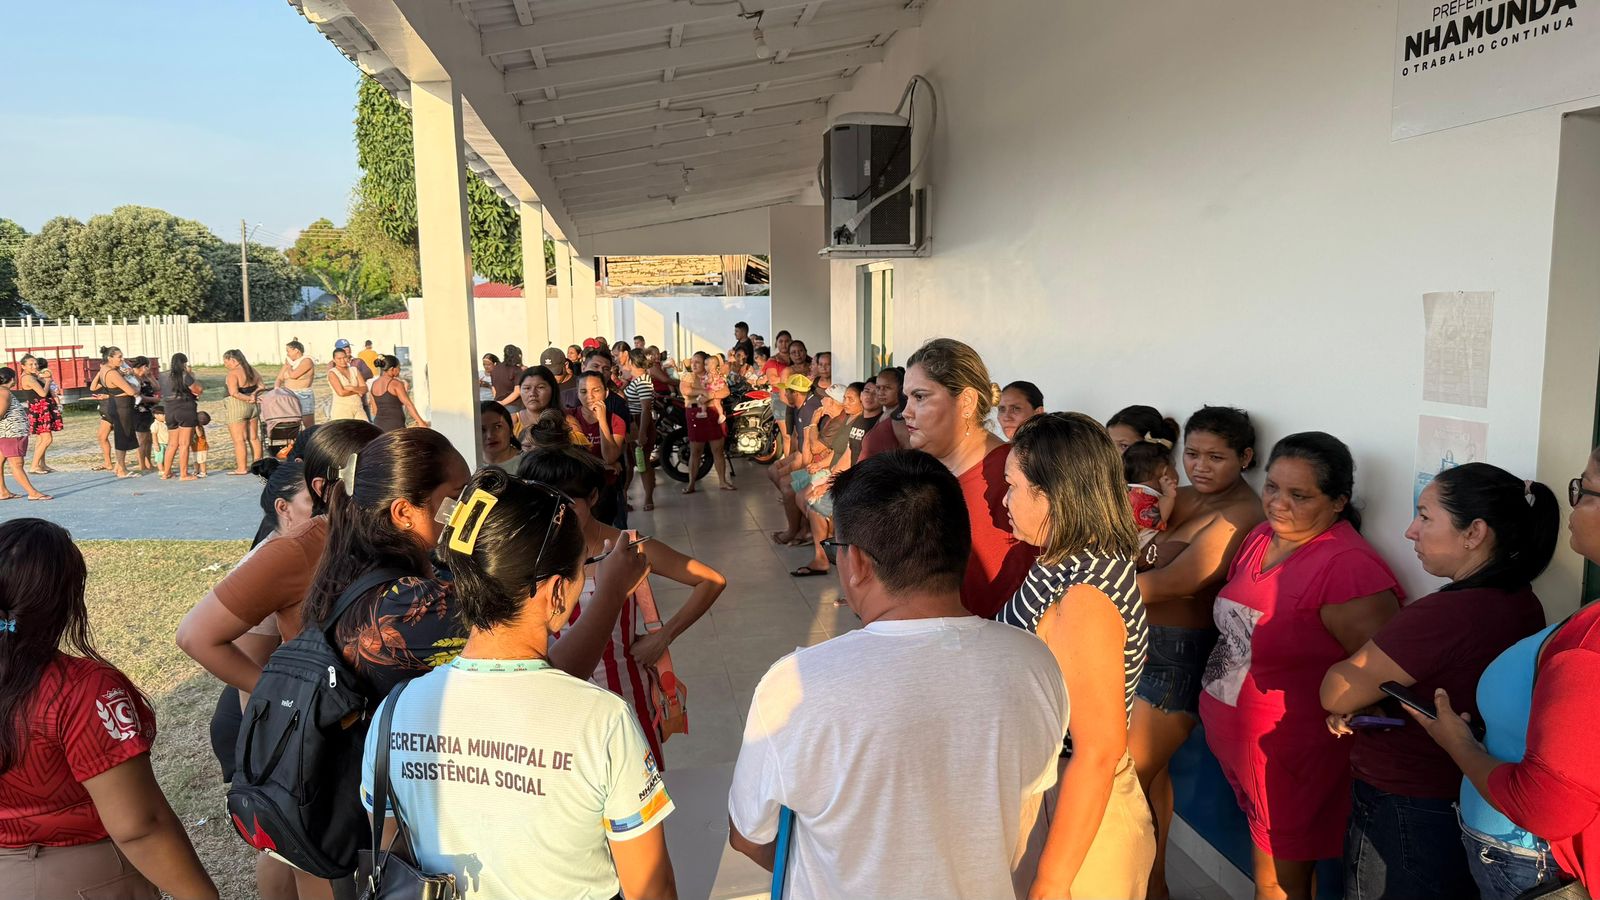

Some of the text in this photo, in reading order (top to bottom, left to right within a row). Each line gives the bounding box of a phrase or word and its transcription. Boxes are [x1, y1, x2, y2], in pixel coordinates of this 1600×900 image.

[1432, 0, 1491, 22] PREFE
[1402, 17, 1574, 76] O TRABALHO CONTINUA
[390, 732, 573, 771] ECRETARIA MUNICIPAL DE
[401, 758, 546, 796] ASSISTÊNCIA SOCIAL
